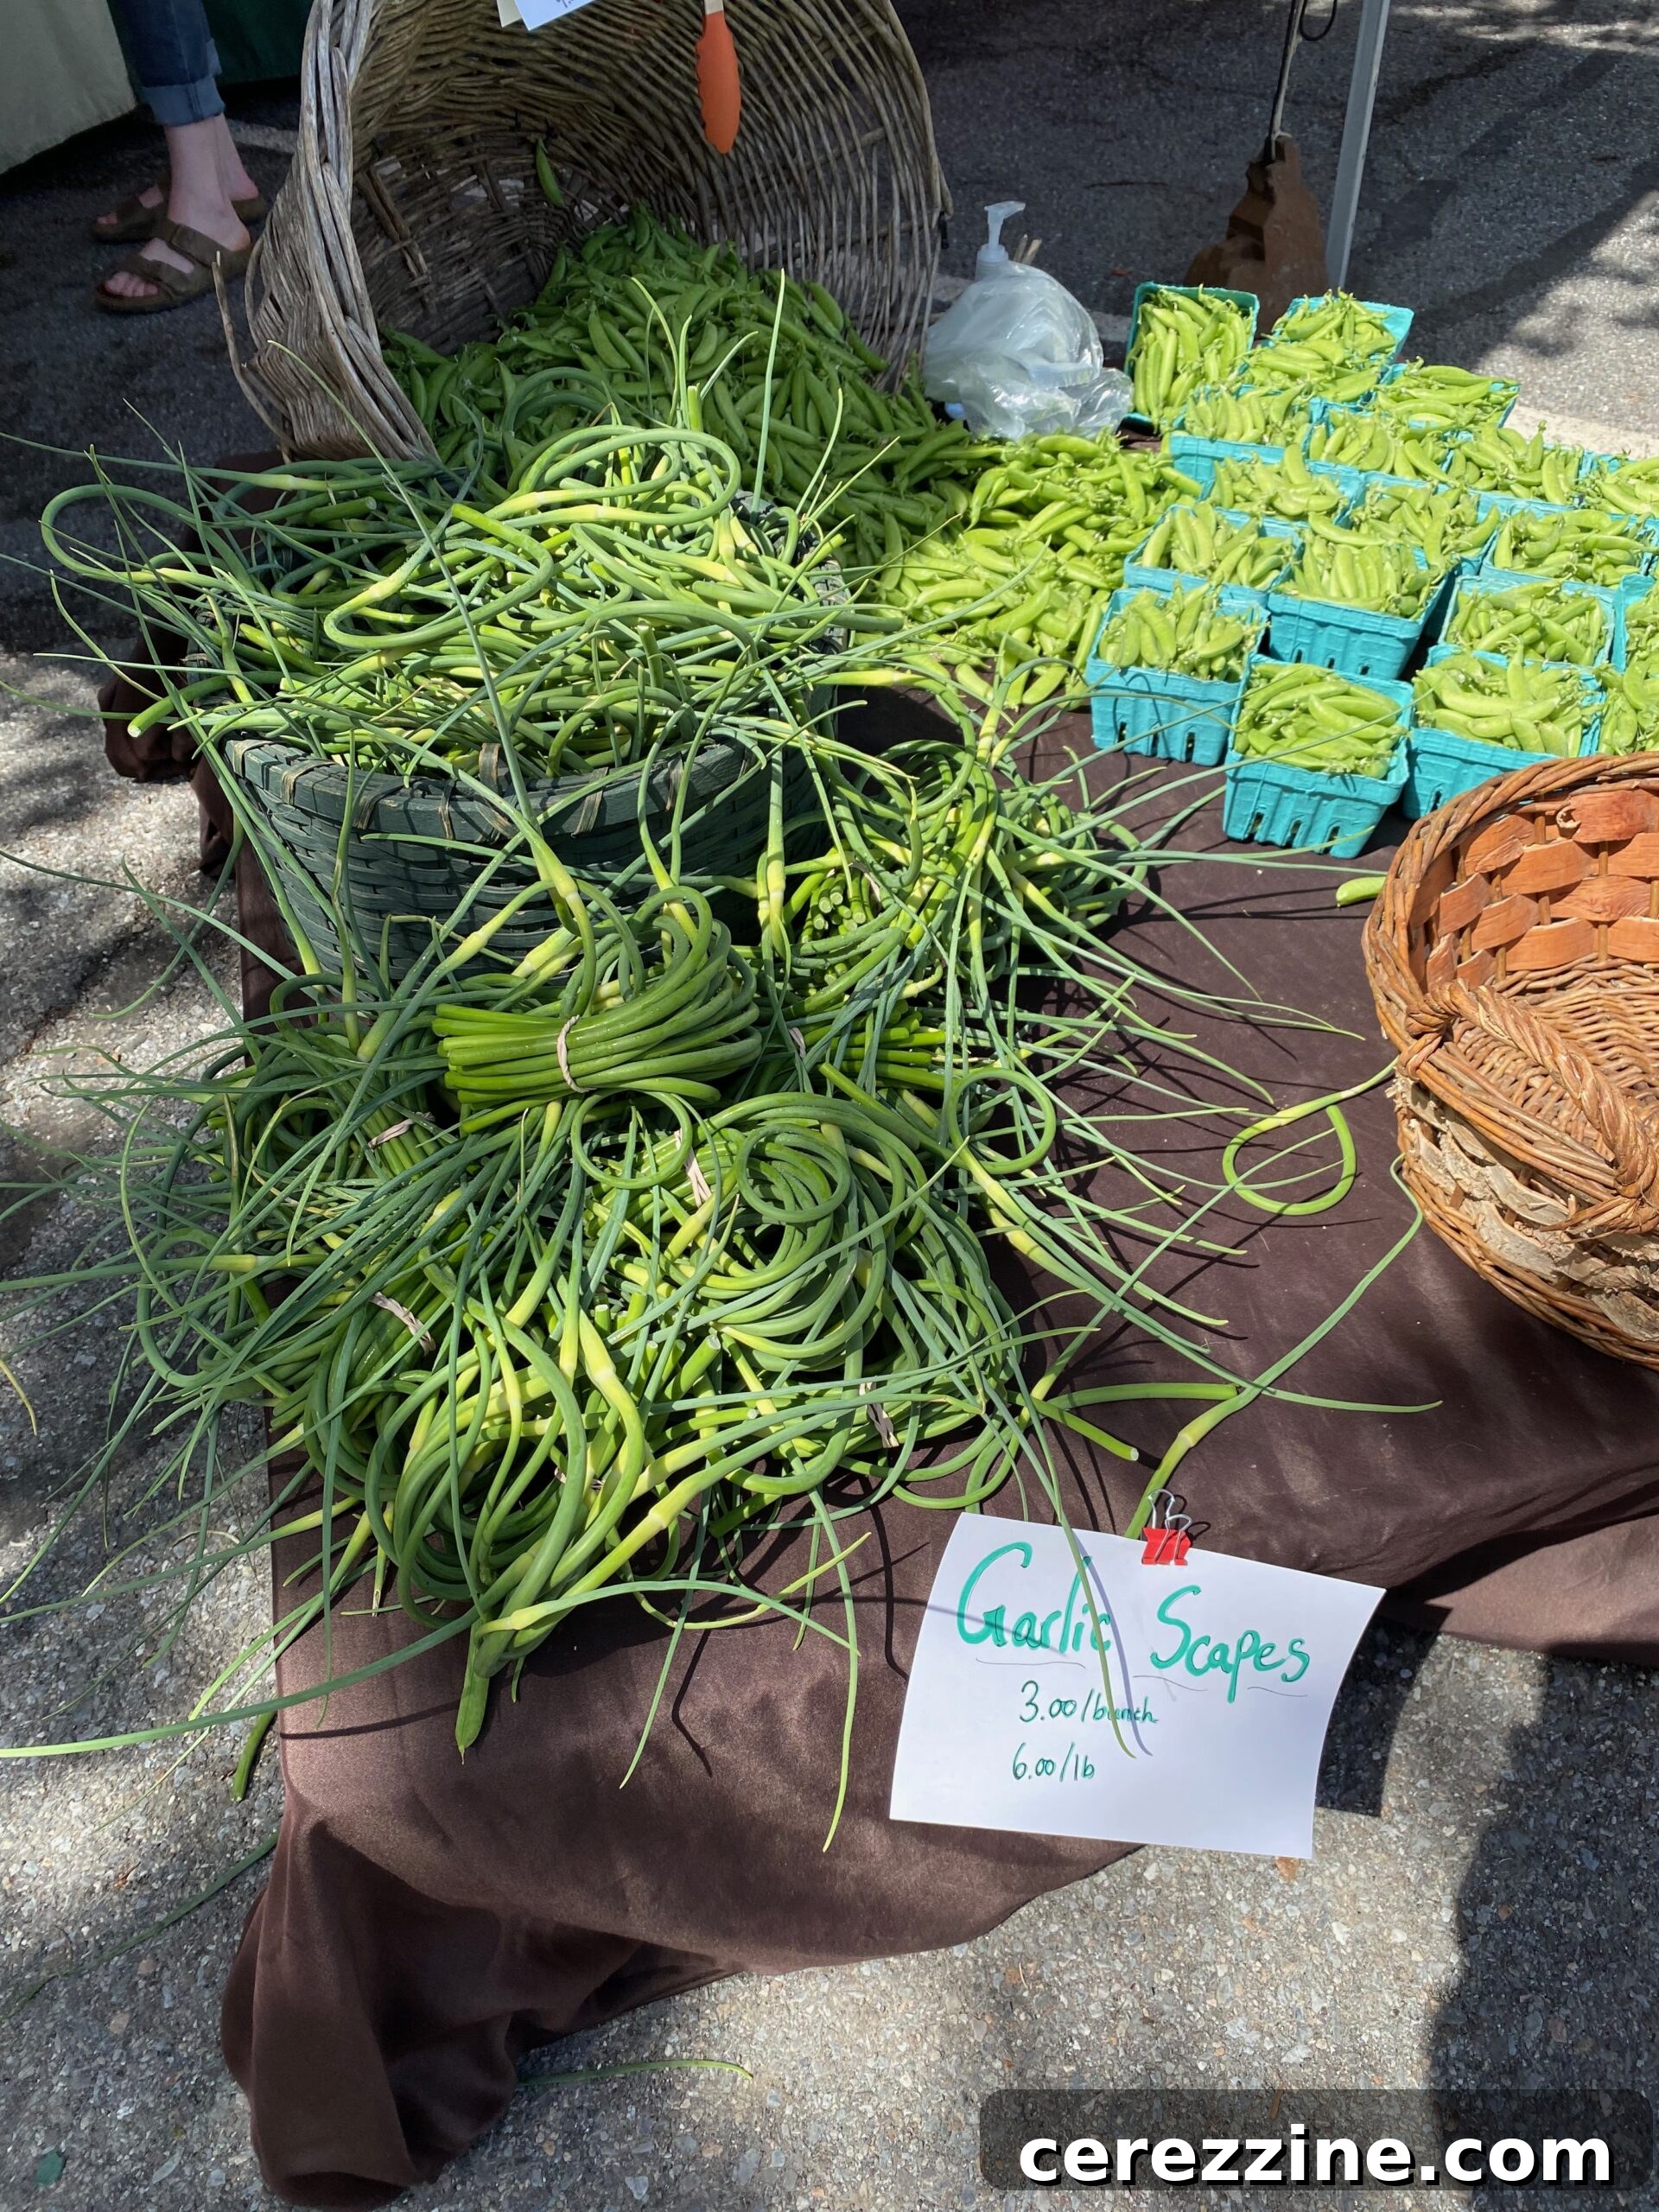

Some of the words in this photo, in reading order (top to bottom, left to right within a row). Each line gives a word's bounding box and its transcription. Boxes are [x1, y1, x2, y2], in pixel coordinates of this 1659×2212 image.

[957, 1541, 1112, 1654] Garlic
[1150, 1584, 1311, 1703] Scapes
[1012, 1741, 1096, 1783] 6.00/lb
